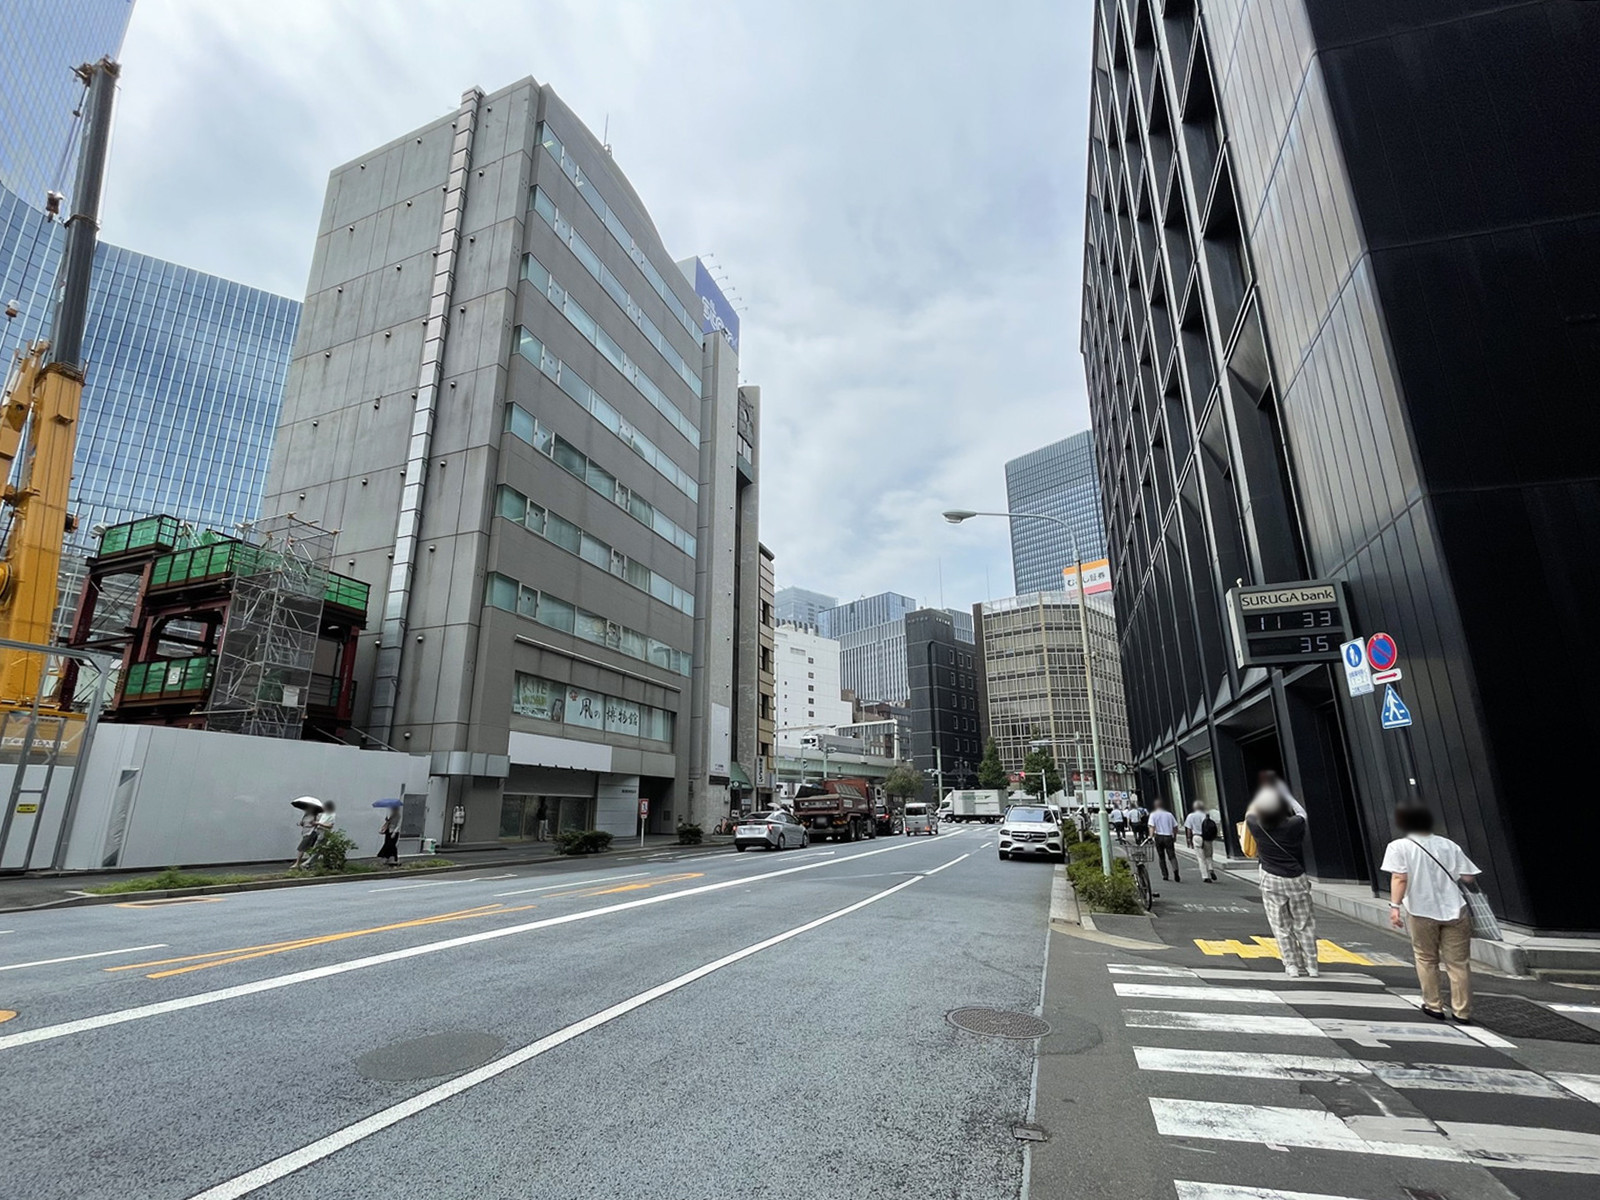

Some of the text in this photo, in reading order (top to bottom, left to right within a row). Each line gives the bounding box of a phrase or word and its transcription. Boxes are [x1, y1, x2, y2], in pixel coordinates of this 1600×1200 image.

[1242, 590, 1334, 607] SURUGA bank
[1300, 635, 1329, 653] 35
